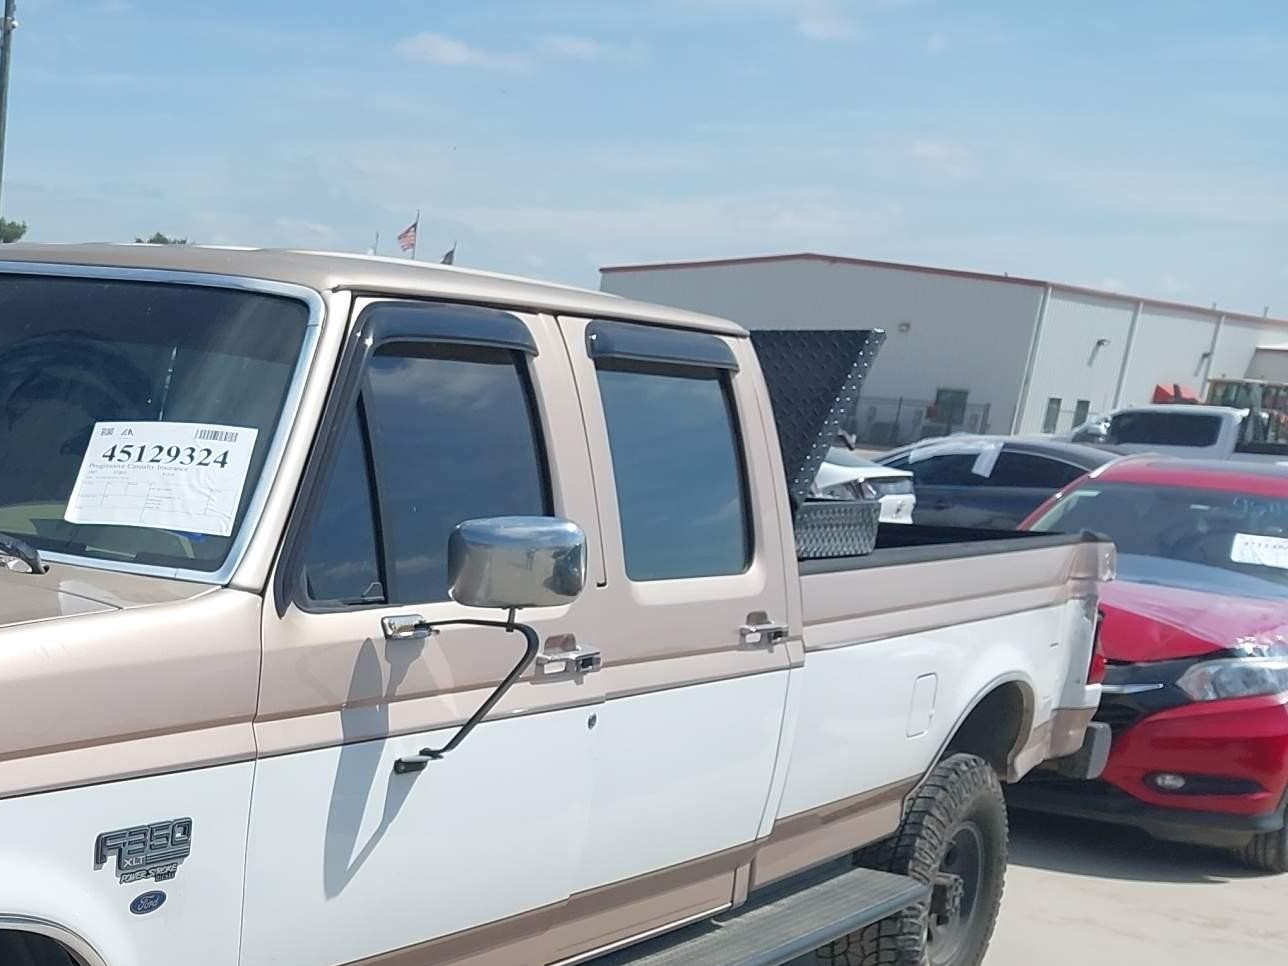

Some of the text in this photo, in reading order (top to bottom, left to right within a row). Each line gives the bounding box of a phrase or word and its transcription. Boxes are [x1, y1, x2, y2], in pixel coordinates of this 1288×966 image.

[102, 443, 230, 469] 45129324
[123, 855, 145, 868] XLT
[121, 869, 147, 884] POWER
